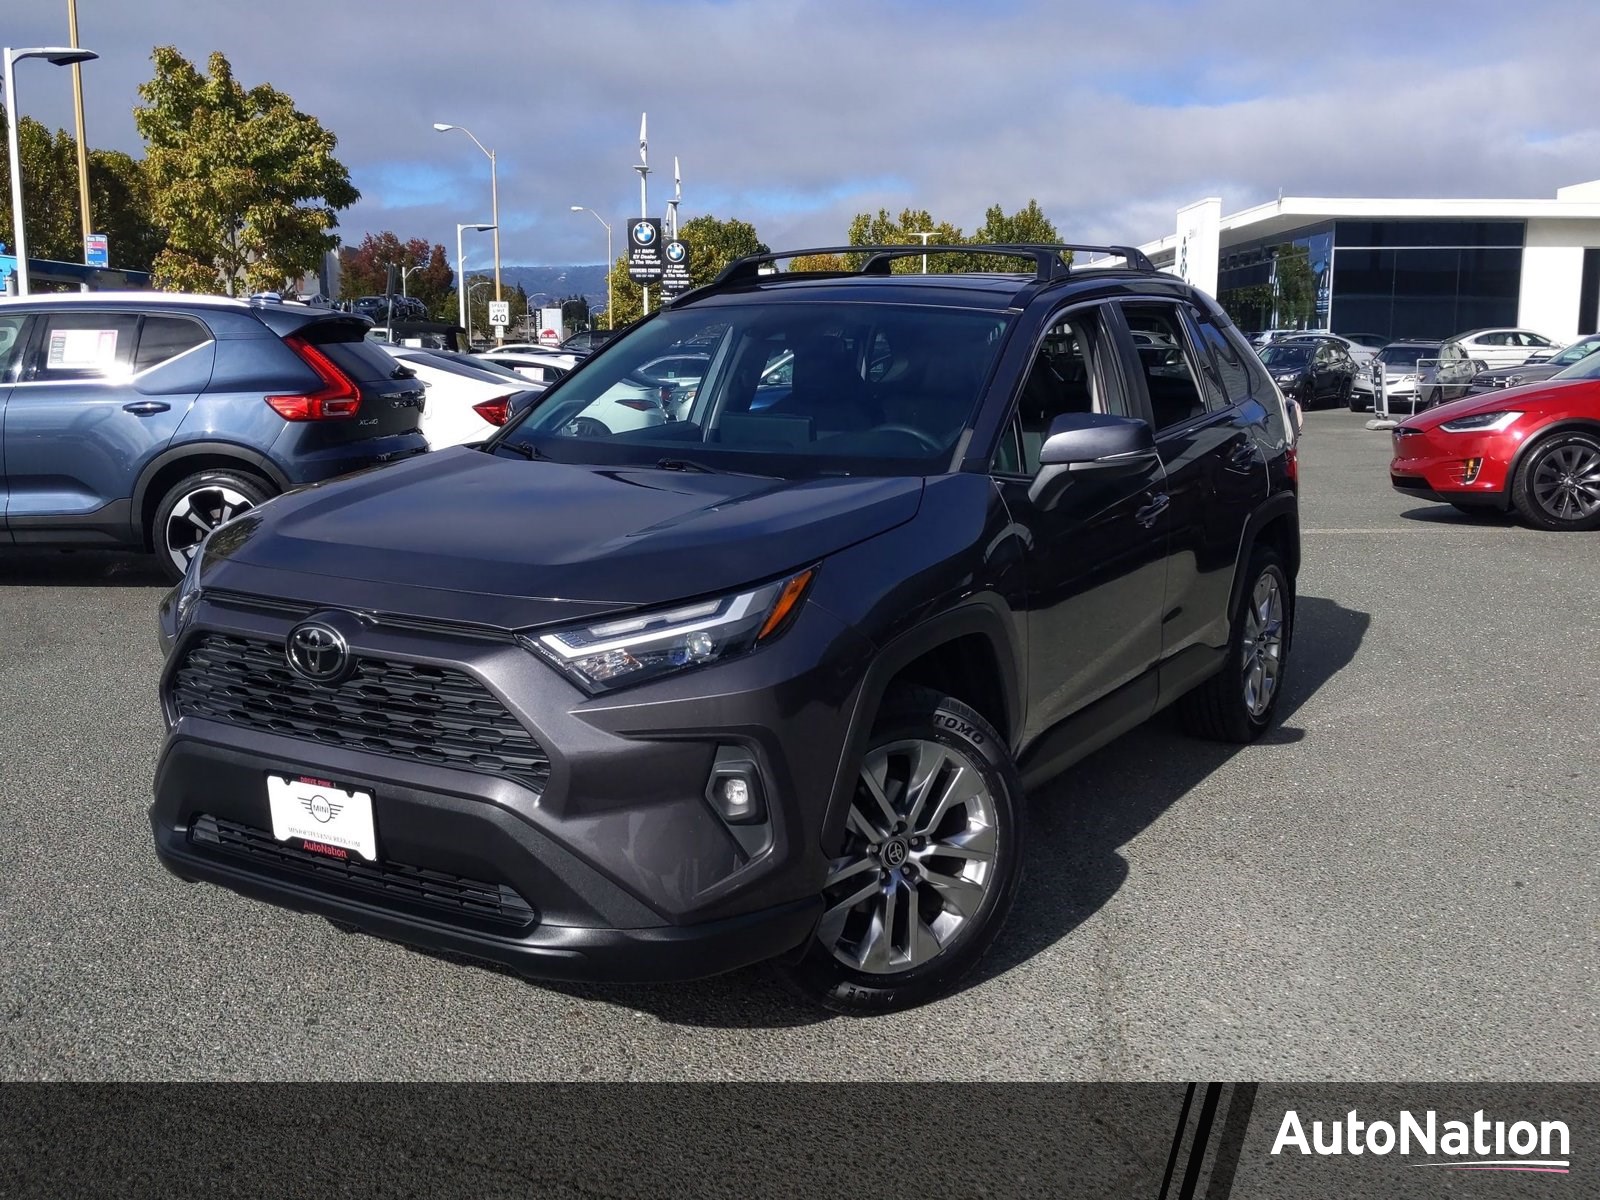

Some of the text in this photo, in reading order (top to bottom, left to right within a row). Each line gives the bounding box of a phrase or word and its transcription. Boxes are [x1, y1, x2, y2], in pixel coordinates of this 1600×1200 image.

[492, 314, 506, 322] 40
[934, 713, 985, 746] TOMO
[312, 804, 330, 814] MINI
[303, 840, 348, 858] AutoNation
